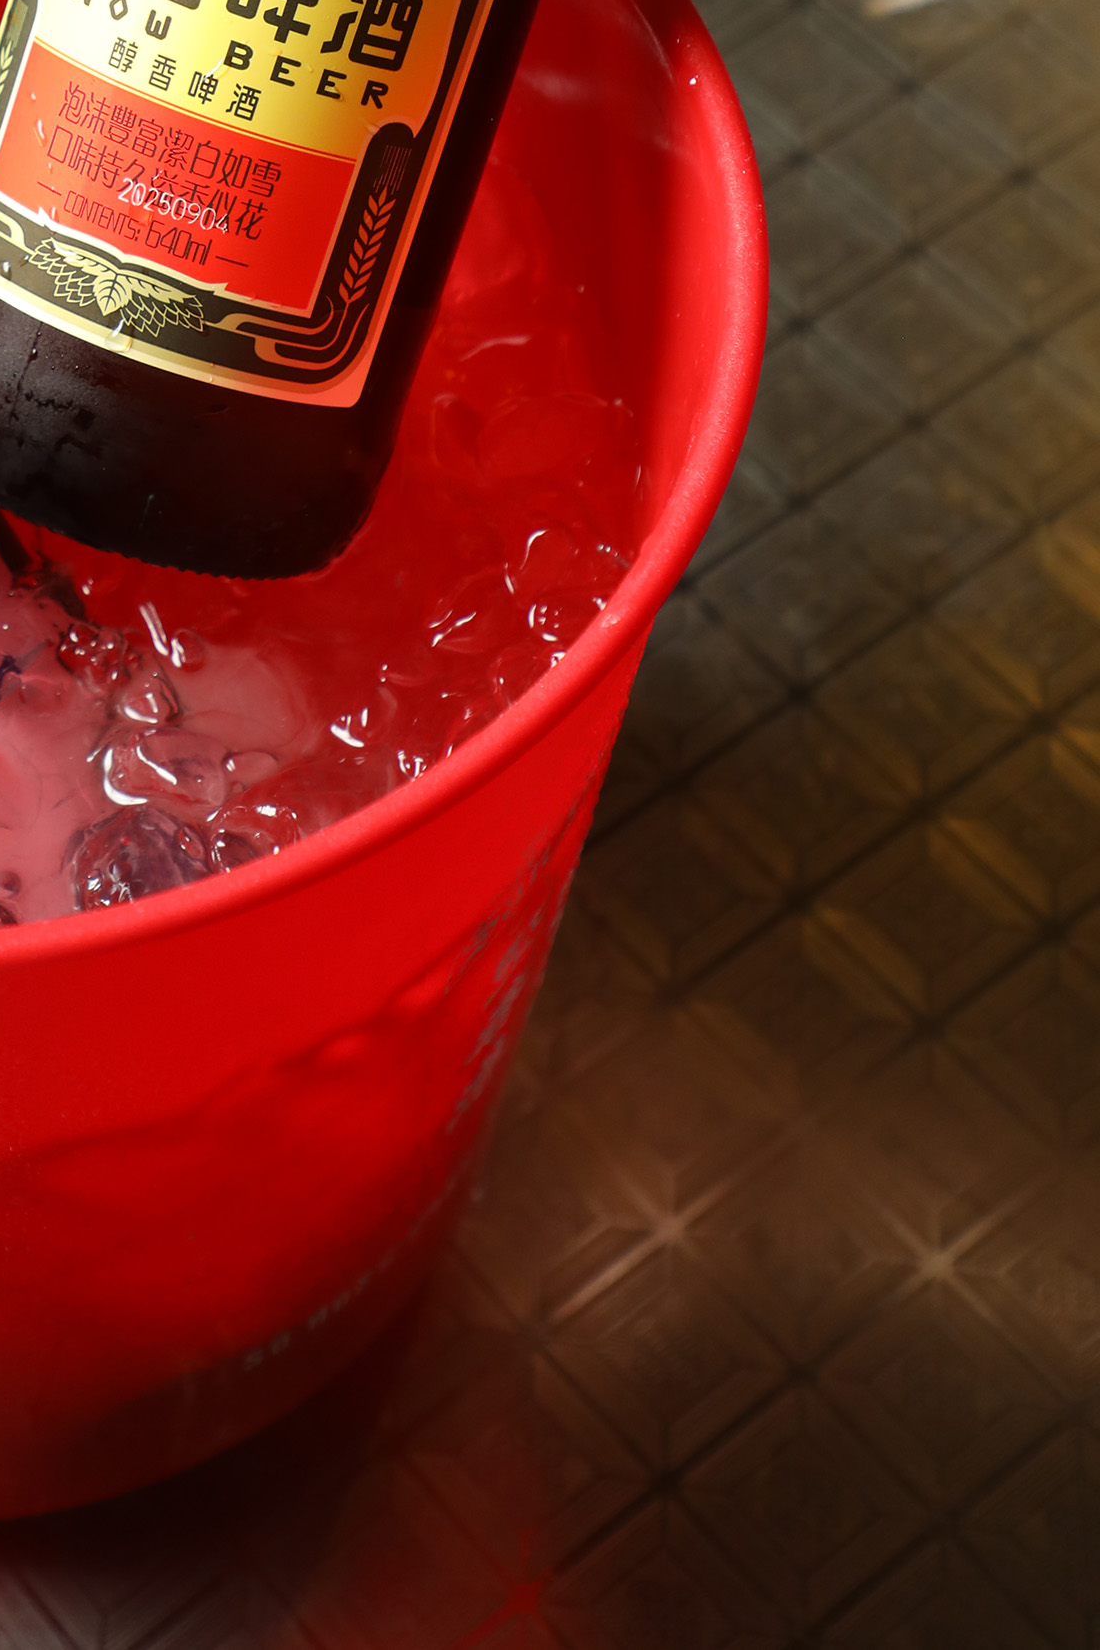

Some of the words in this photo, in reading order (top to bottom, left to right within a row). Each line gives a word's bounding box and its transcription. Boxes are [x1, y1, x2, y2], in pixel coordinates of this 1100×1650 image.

[108, 37, 262, 121] 醇香啤酒
[223, 40, 389, 110] BEER
[64, 190, 141, 242] CONTENTS:
[145, 219, 213, 266] 640ml
[117, 178, 229, 234] 20250904
